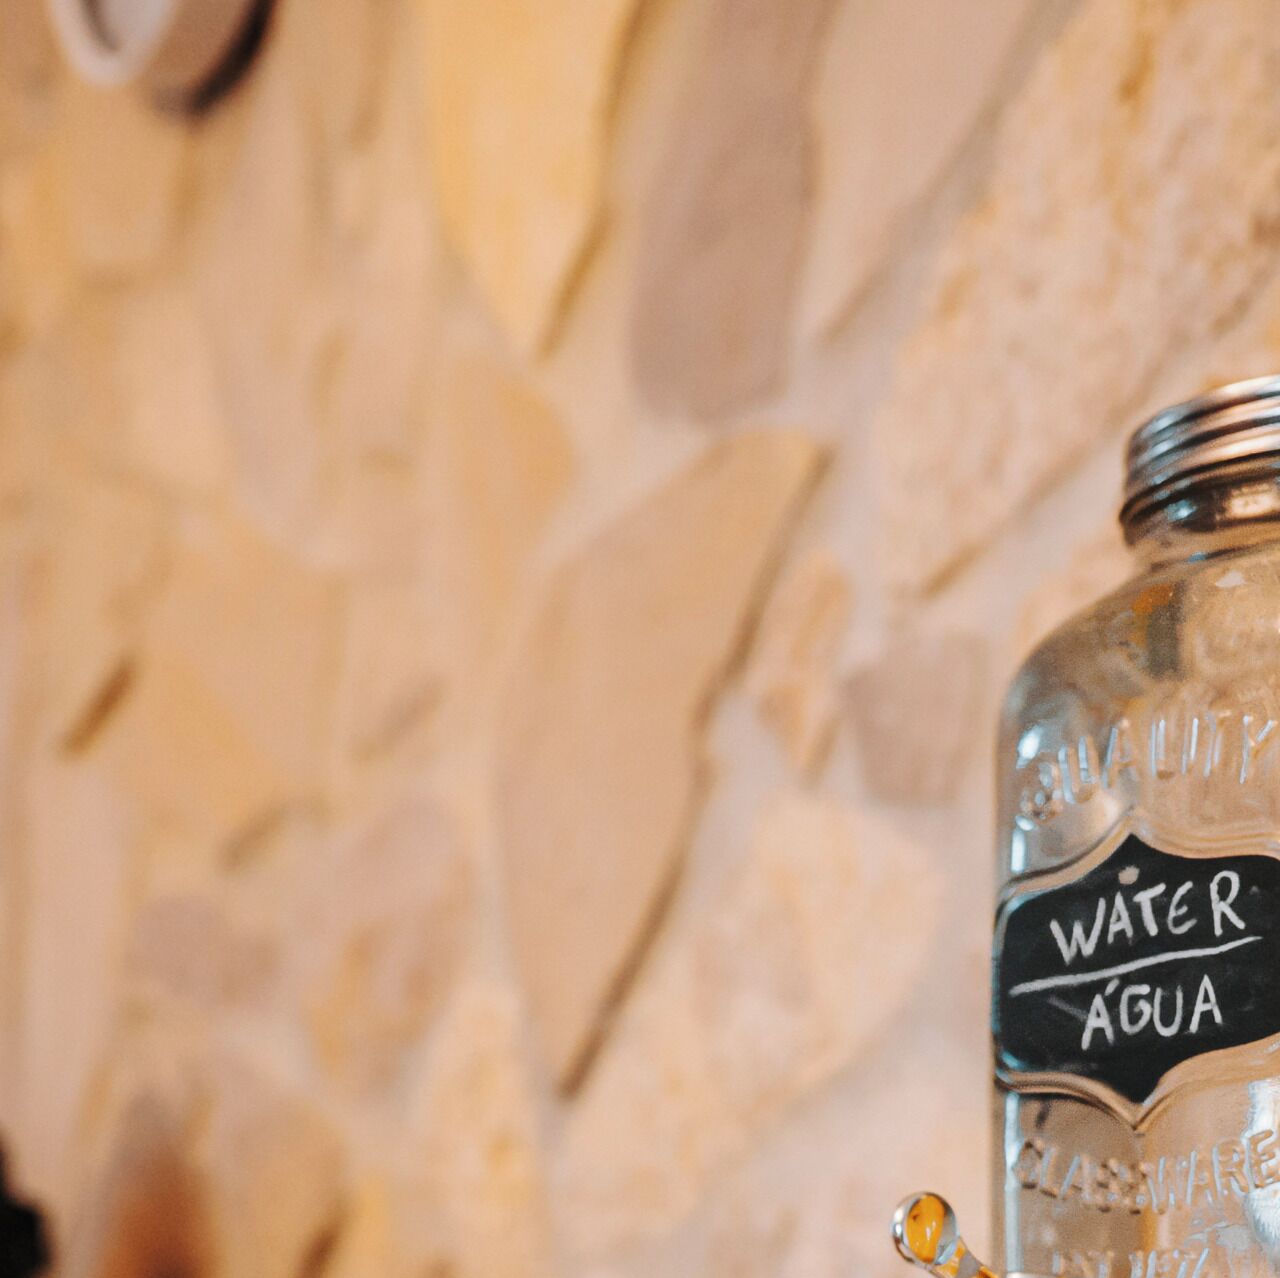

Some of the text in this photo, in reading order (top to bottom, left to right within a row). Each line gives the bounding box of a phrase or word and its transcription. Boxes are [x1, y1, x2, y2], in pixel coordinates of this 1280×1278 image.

[1019, 712, 1279, 820] QUALITY
[1049, 869, 1246, 966] WATER
[1080, 977, 1223, 1051] ÁGUA
